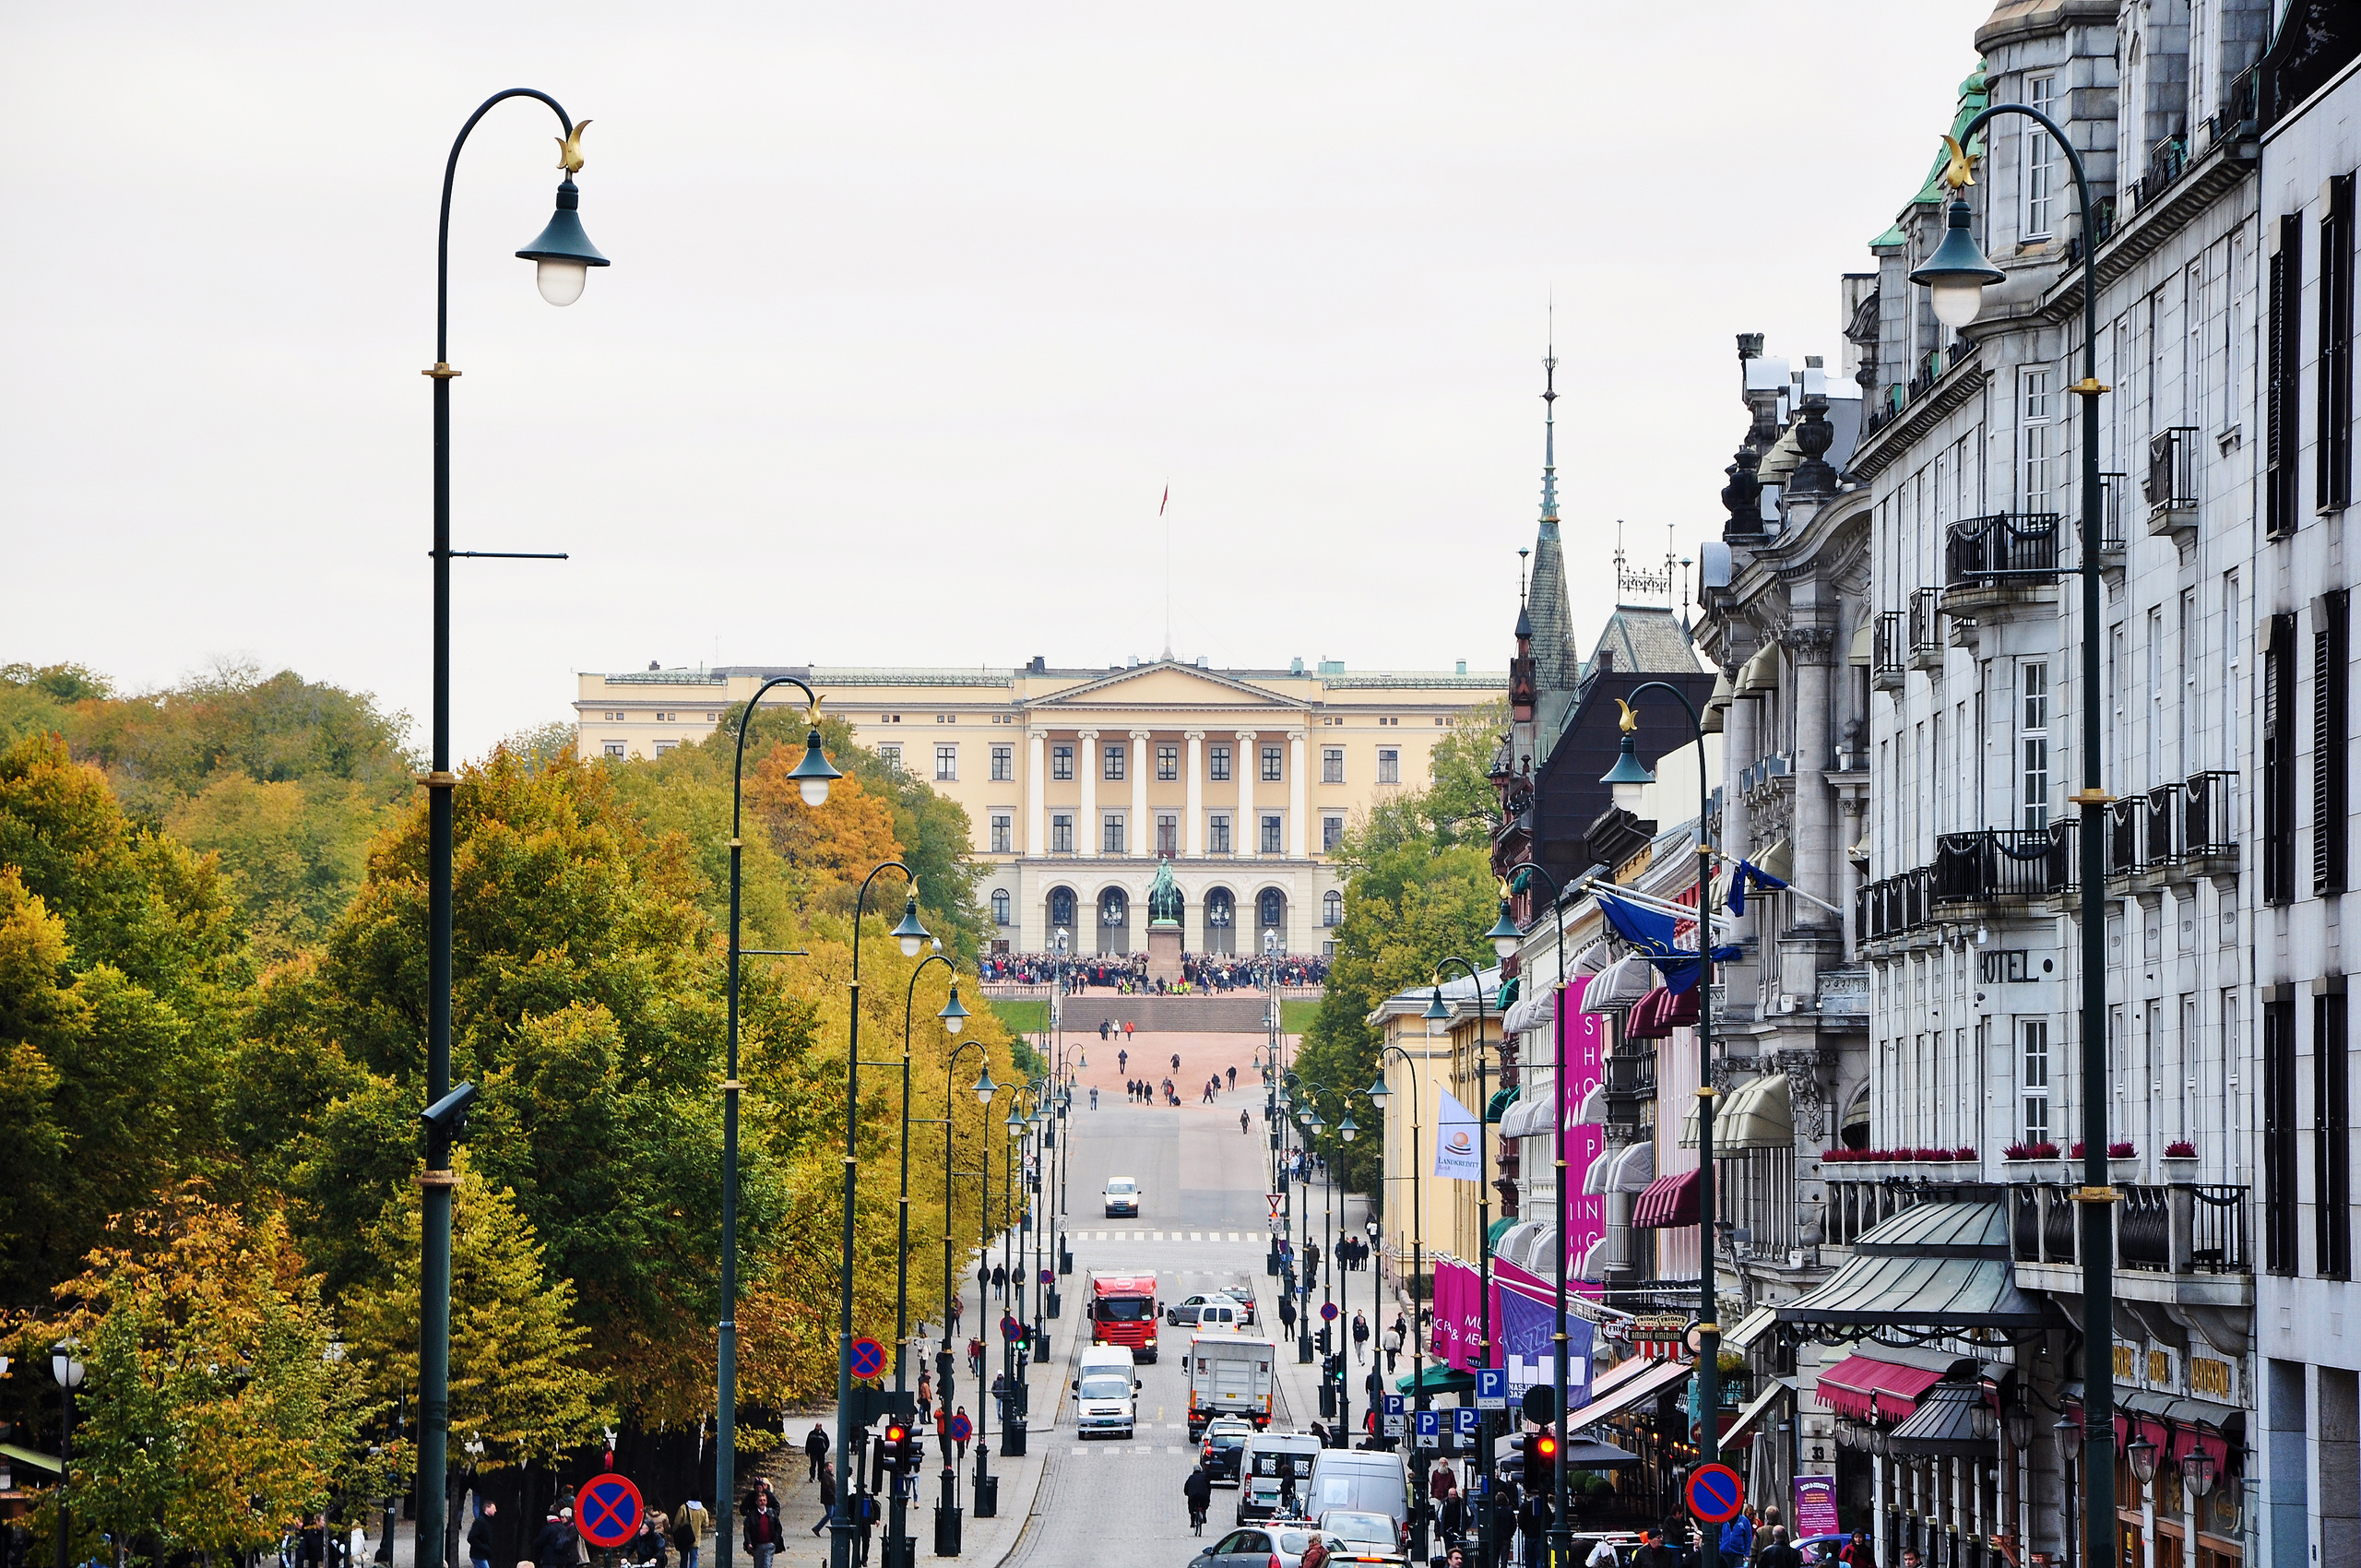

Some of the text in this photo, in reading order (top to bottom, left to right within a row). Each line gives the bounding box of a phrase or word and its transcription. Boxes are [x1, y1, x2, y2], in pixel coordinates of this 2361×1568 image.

[1977, 949, 2039, 984] HOTEL
[1583, 1016, 1598, 1249] SHOPNG
[1483, 1373, 1498, 1395] P
[2191, 1357, 2227, 1398] NARVESEN
[1508, 1384, 1536, 1392] NASJO
[1508, 1391, 1527, 1399] JAZ
[1389, 1397, 1400, 1413] P
[1422, 1415, 1434, 1432] P
[1460, 1410, 1474, 1431] P
[1812, 1446, 1824, 1459] 33
